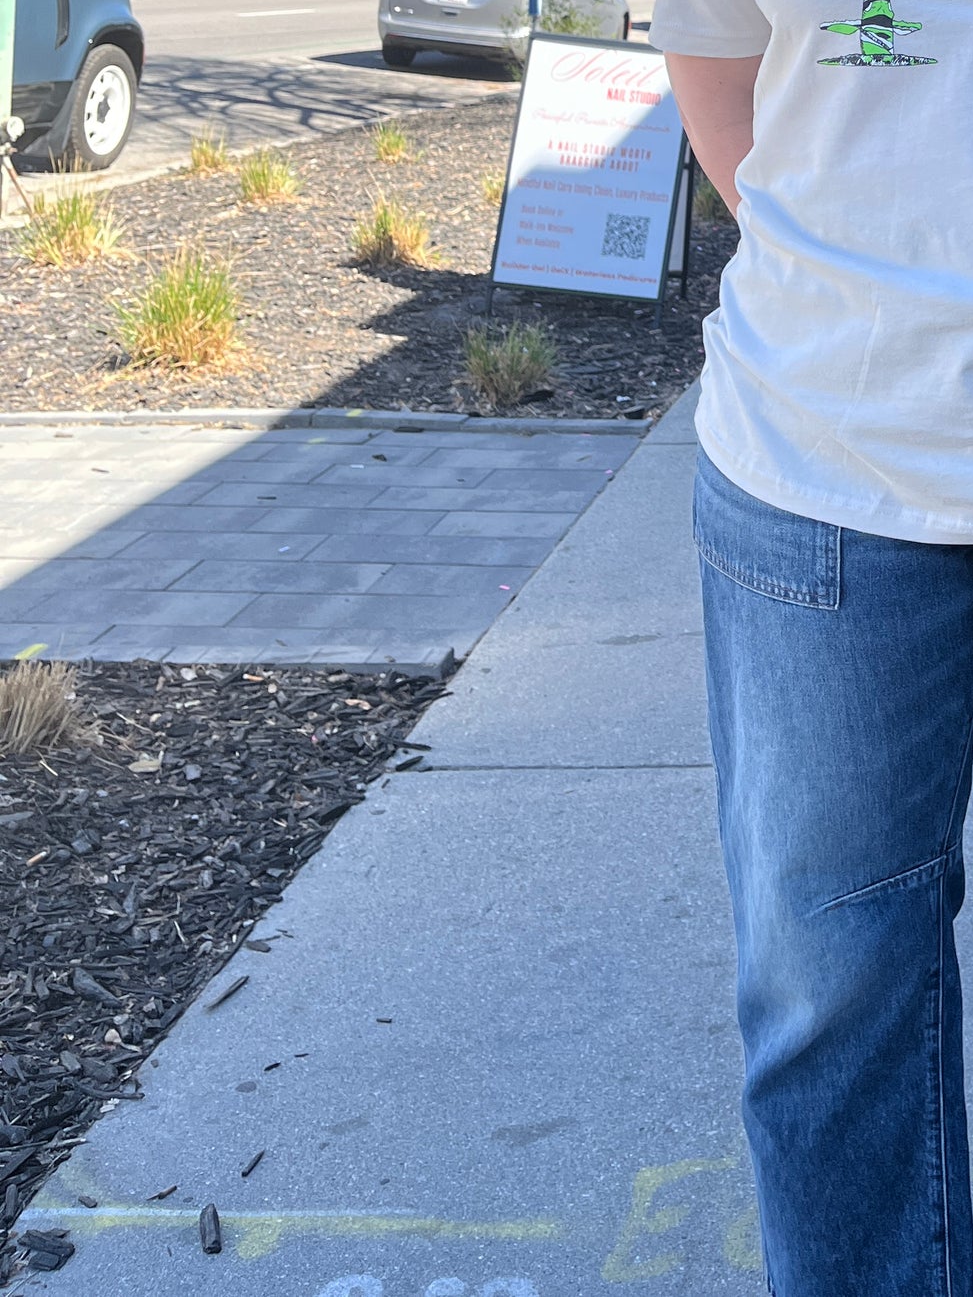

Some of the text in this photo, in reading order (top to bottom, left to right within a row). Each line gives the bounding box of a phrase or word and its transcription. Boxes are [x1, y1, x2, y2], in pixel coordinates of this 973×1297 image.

[551, 49, 665, 88] Soleil
[606, 87, 662, 107] NAIL STUDIO
[548, 139, 652, 161] A NAIL STUDIO WORTH
[560, 153, 640, 173] BRAGGING ABOUT
[543, 179, 556, 191] Nail
[557, 180, 572, 194] Care
[615, 187, 638, 202] Luxury
[640, 190, 669, 204] Products
